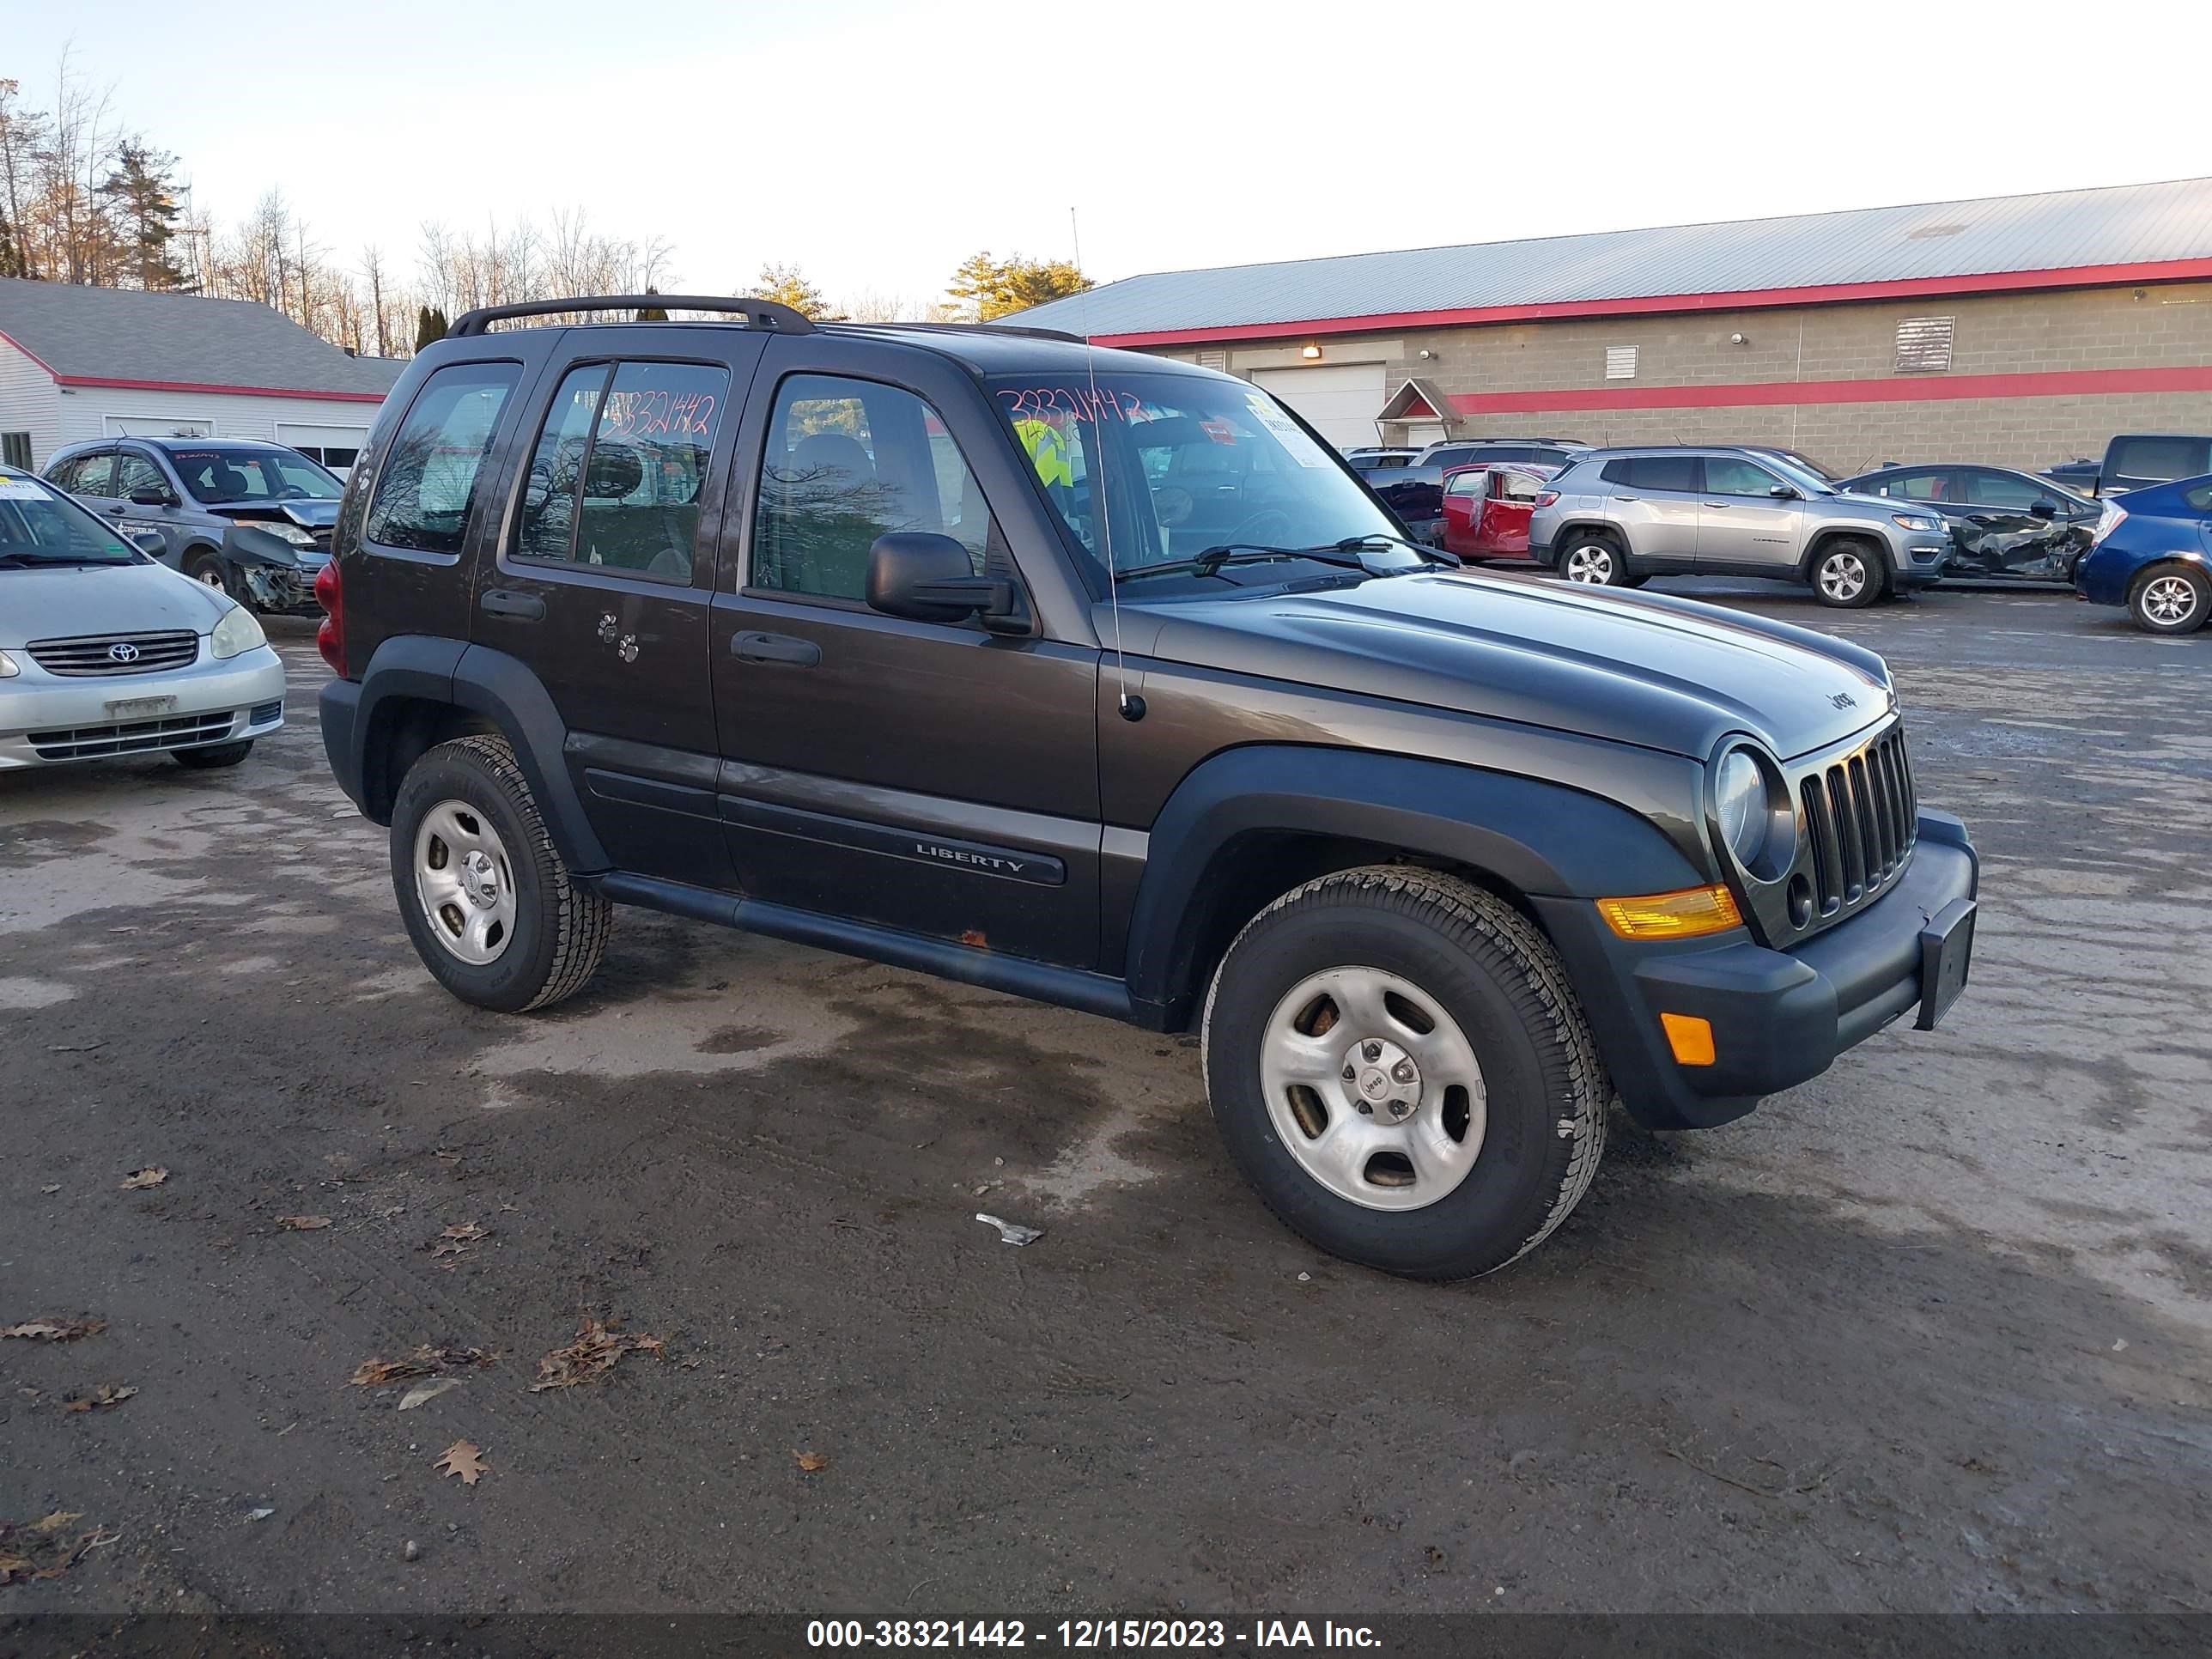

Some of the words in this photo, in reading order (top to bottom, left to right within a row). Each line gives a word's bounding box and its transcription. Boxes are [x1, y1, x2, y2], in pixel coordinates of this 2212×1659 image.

[996, 387, 1153, 427] 38321442
[915, 844, 1024, 872] LIBERTY
[1365, 1076, 1383, 1093] Jeep
